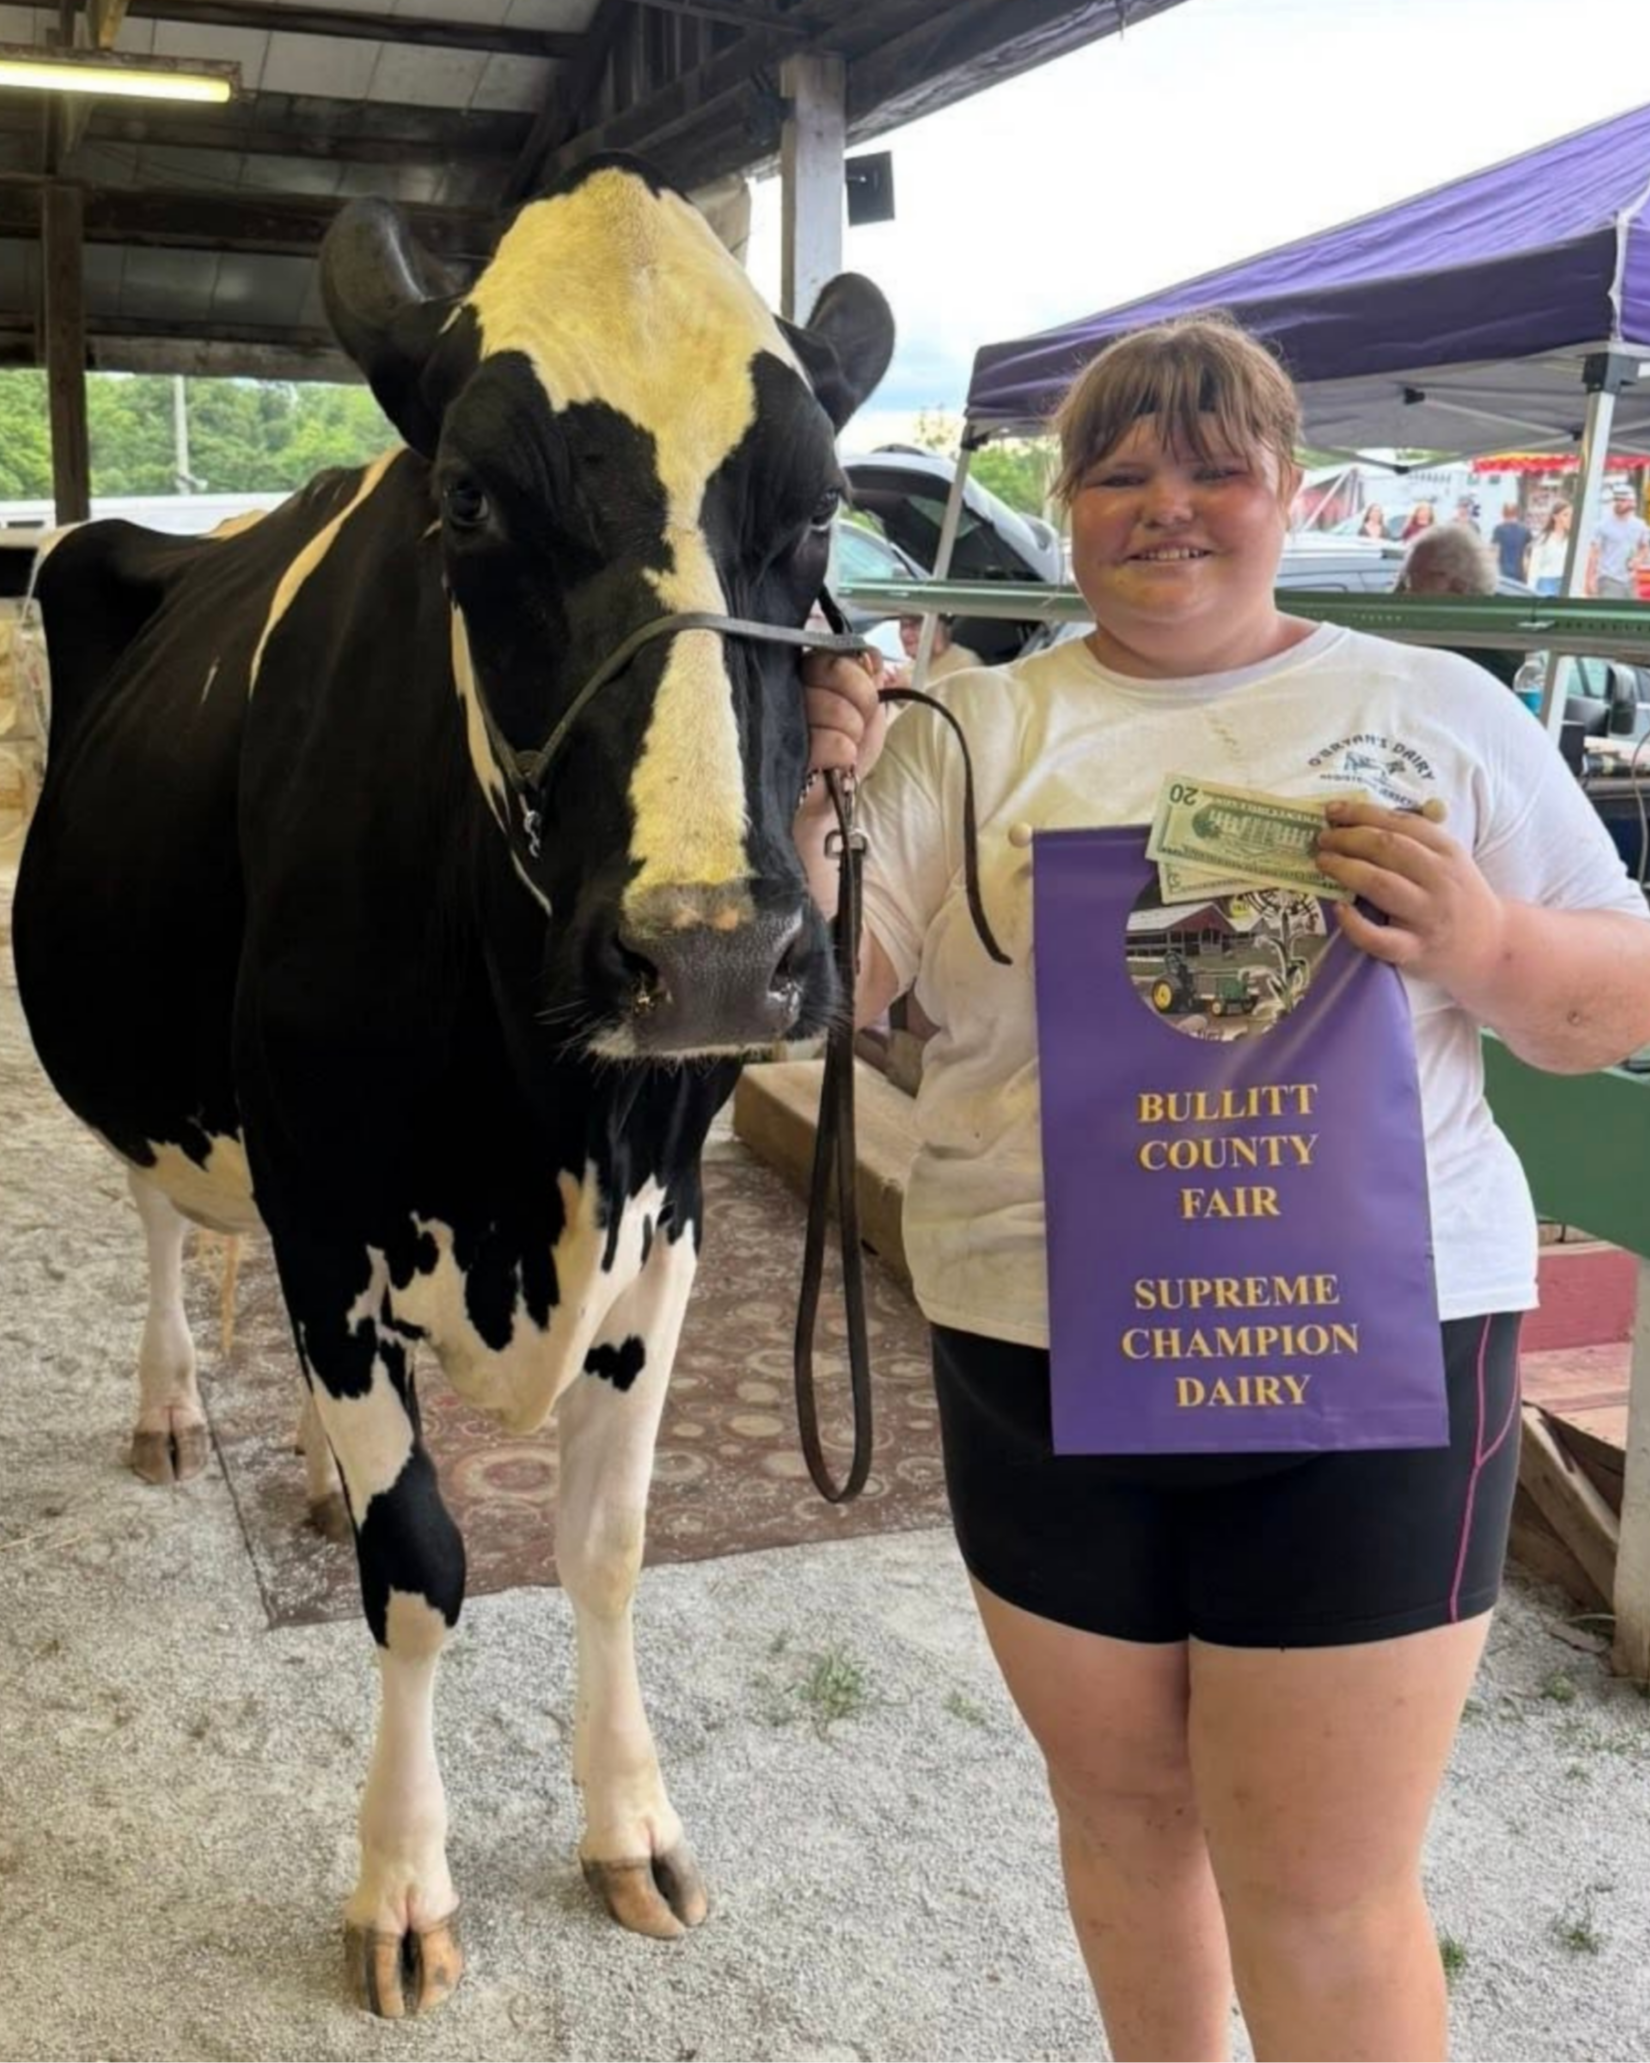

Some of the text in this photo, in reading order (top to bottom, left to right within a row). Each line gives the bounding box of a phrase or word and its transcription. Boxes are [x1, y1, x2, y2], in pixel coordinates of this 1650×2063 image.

[1392, 742, 1435, 780] DAIRY
[1169, 783, 1199, 806] 20
[1138, 1084, 1319, 1123] BULLITT
[1139, 1134, 1319, 1171] COUNTY
[1181, 1186, 1281, 1219] FAIR
[1134, 1274, 1340, 1309] SUPREME
[1122, 1323, 1359, 1359] CHAMPION
[1175, 1375, 1312, 1407] DAIRY
